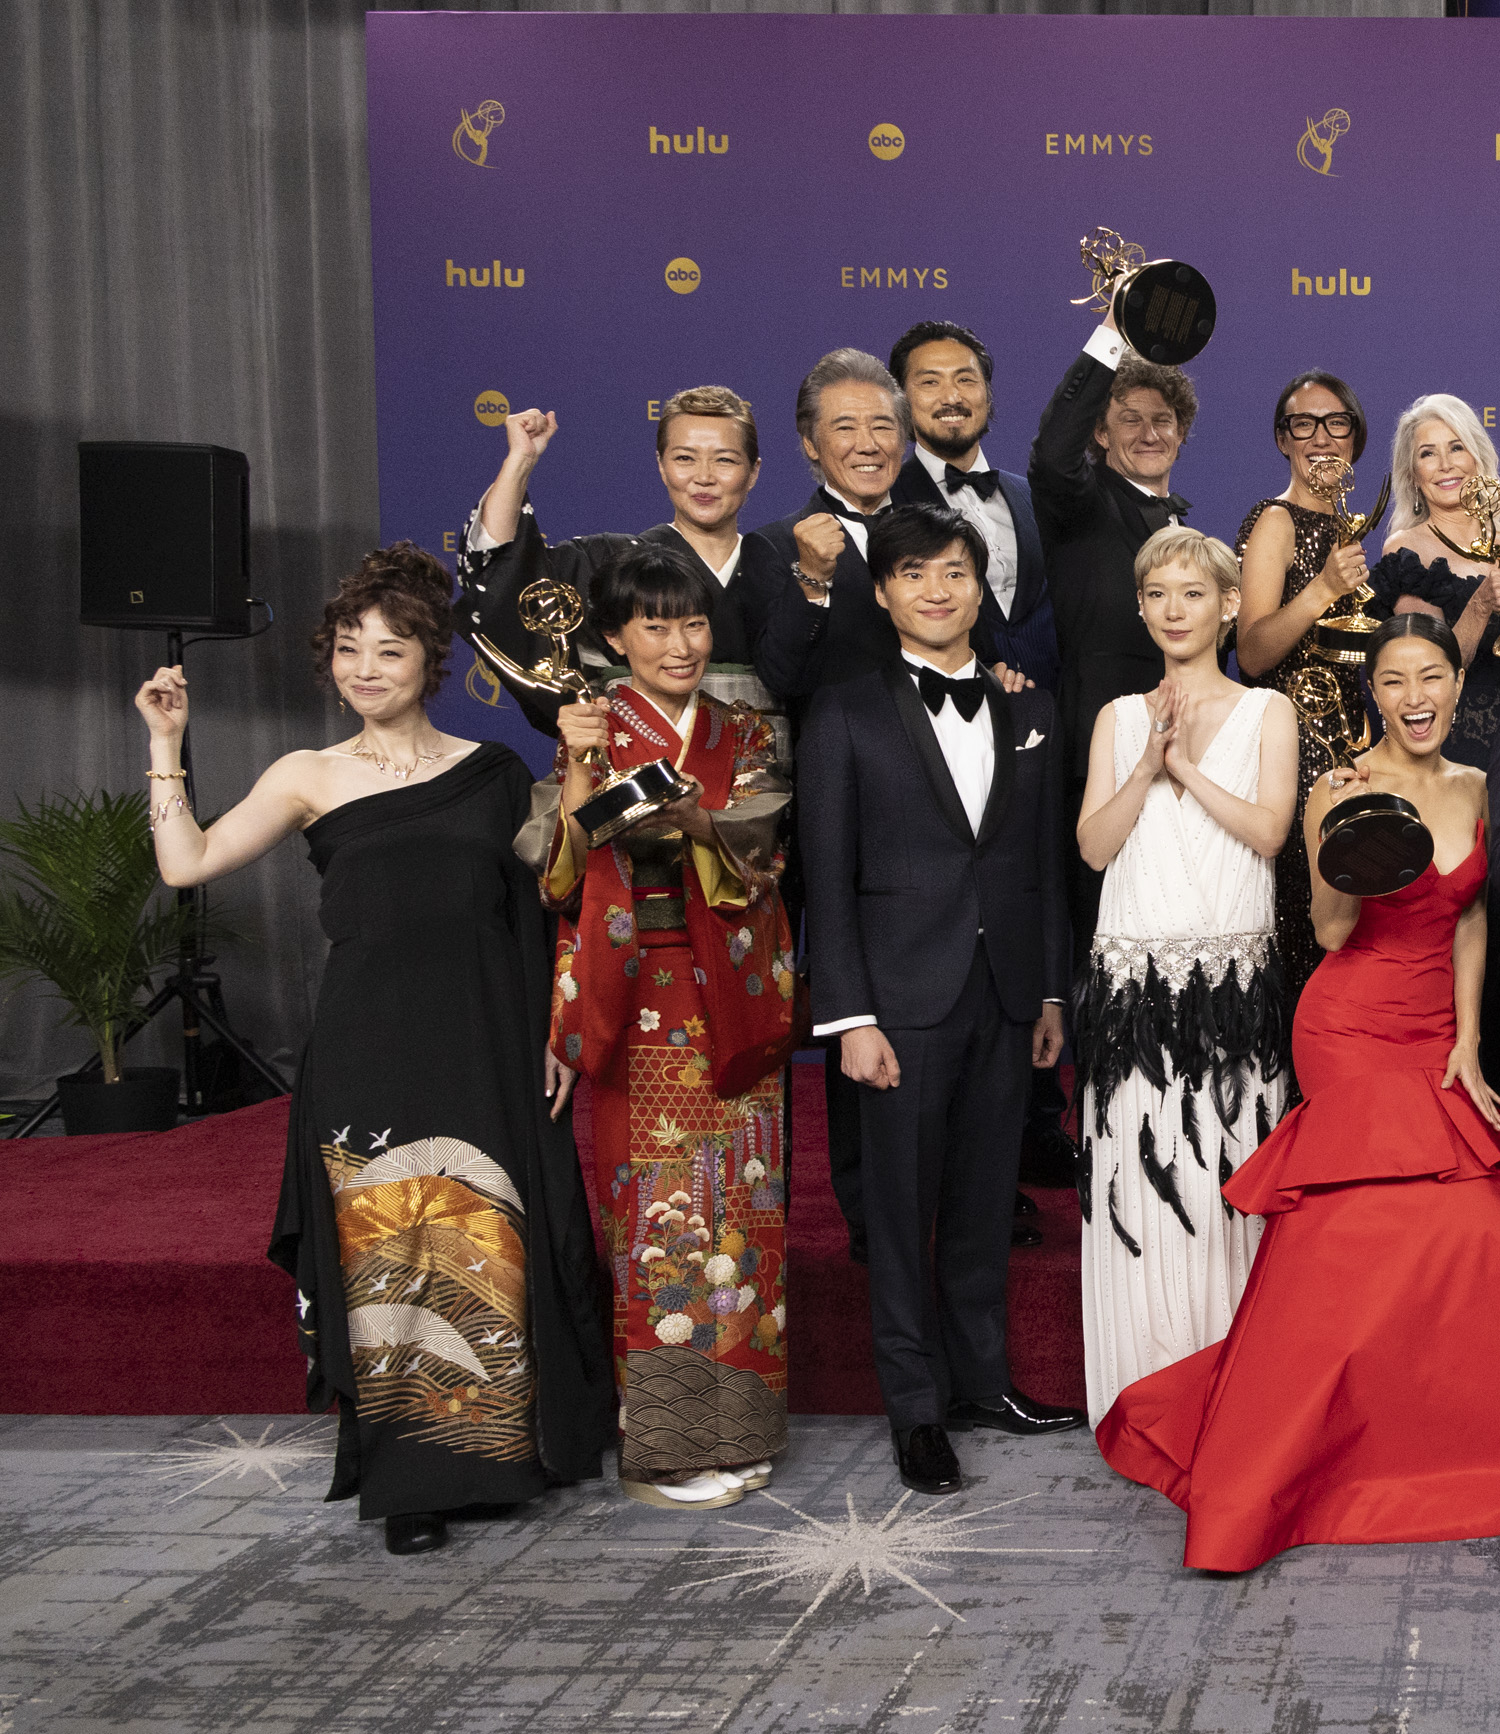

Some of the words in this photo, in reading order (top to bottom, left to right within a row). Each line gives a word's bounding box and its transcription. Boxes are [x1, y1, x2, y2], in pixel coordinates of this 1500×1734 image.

[649, 126, 728, 154] hulu
[871, 134, 902, 147] abc
[1046, 134, 1152, 155] EMMYS
[446, 259, 524, 287] hulu
[668, 268, 699, 281] abc
[842, 267, 947, 289] EMMYS
[1292, 268, 1371, 295] hulu
[477, 401, 508, 414] abc
